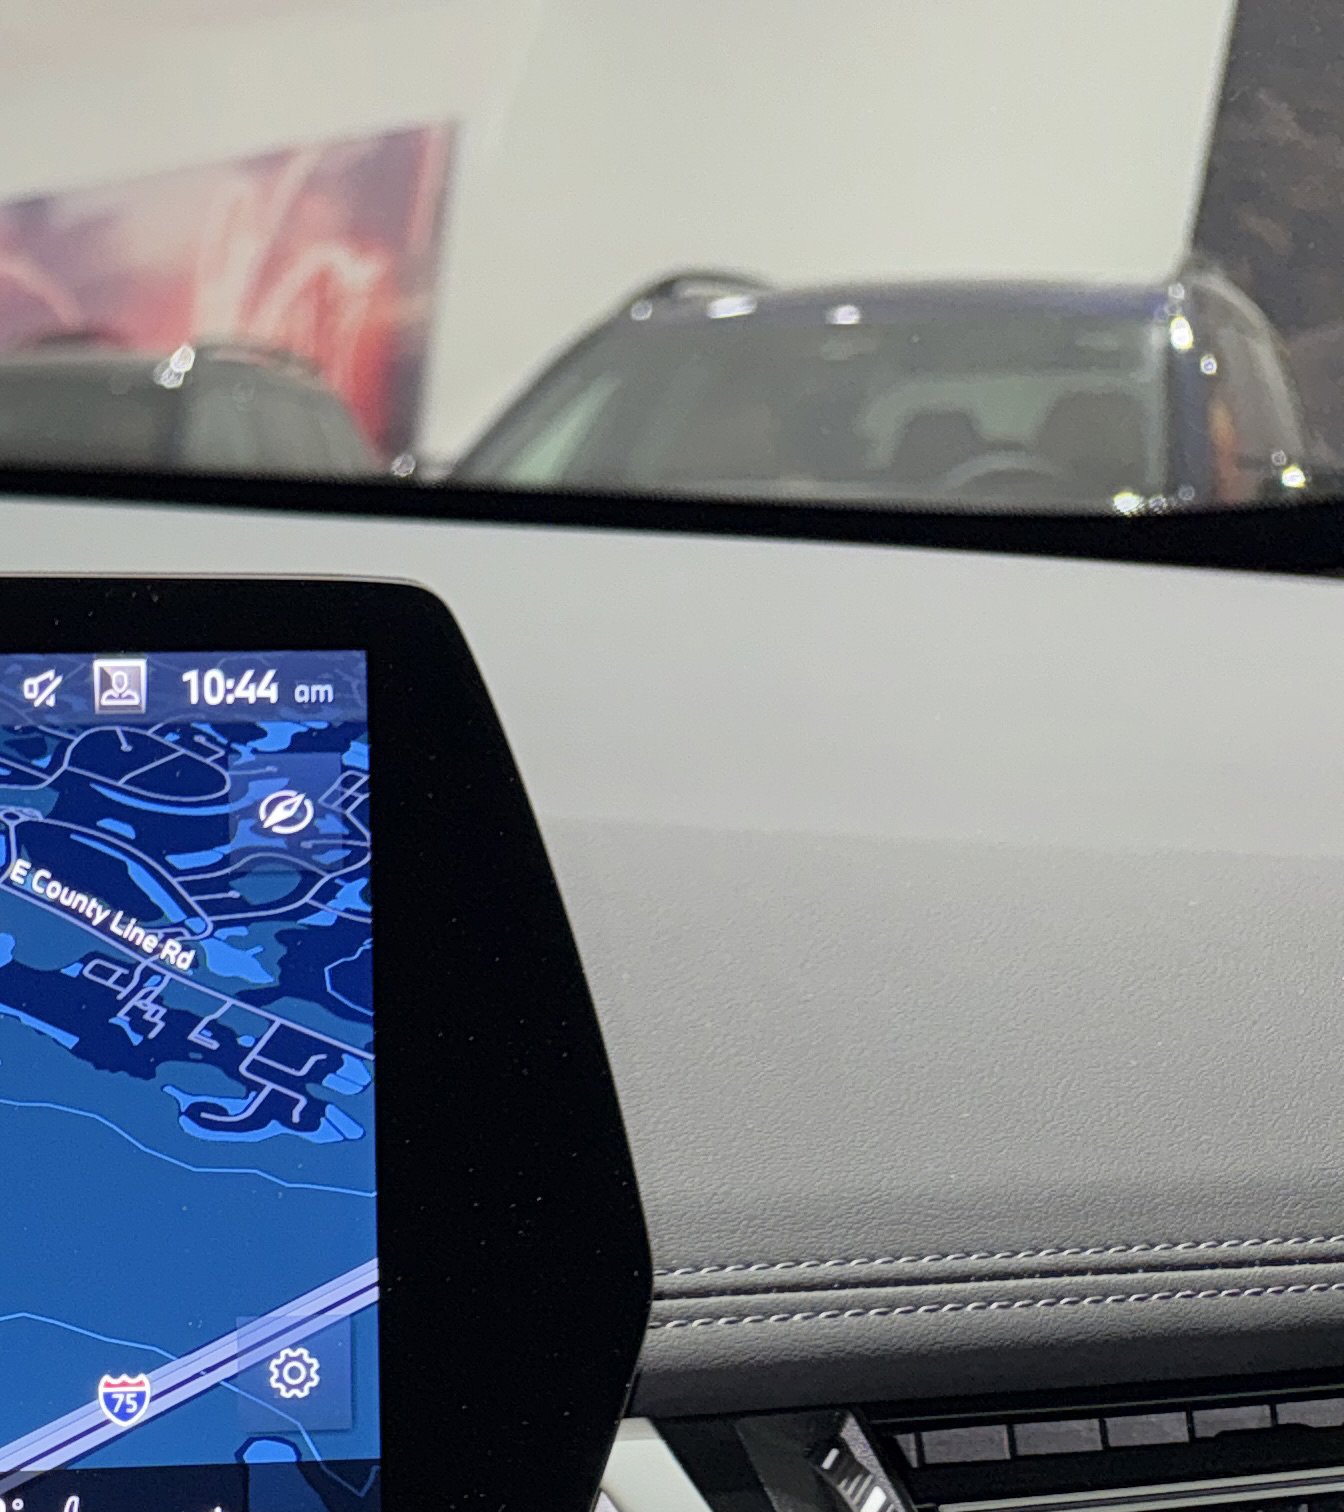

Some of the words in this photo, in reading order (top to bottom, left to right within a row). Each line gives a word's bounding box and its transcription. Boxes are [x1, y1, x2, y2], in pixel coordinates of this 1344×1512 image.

[181, 668, 280, 706] 10:44
[293, 681, 334, 705] am
[9, 857, 32, 886] E
[31, 867, 111, 927] County
[109, 909, 159, 954] Line
[160, 937, 196, 971] Rd
[111, 1393, 138, 1414] 75
